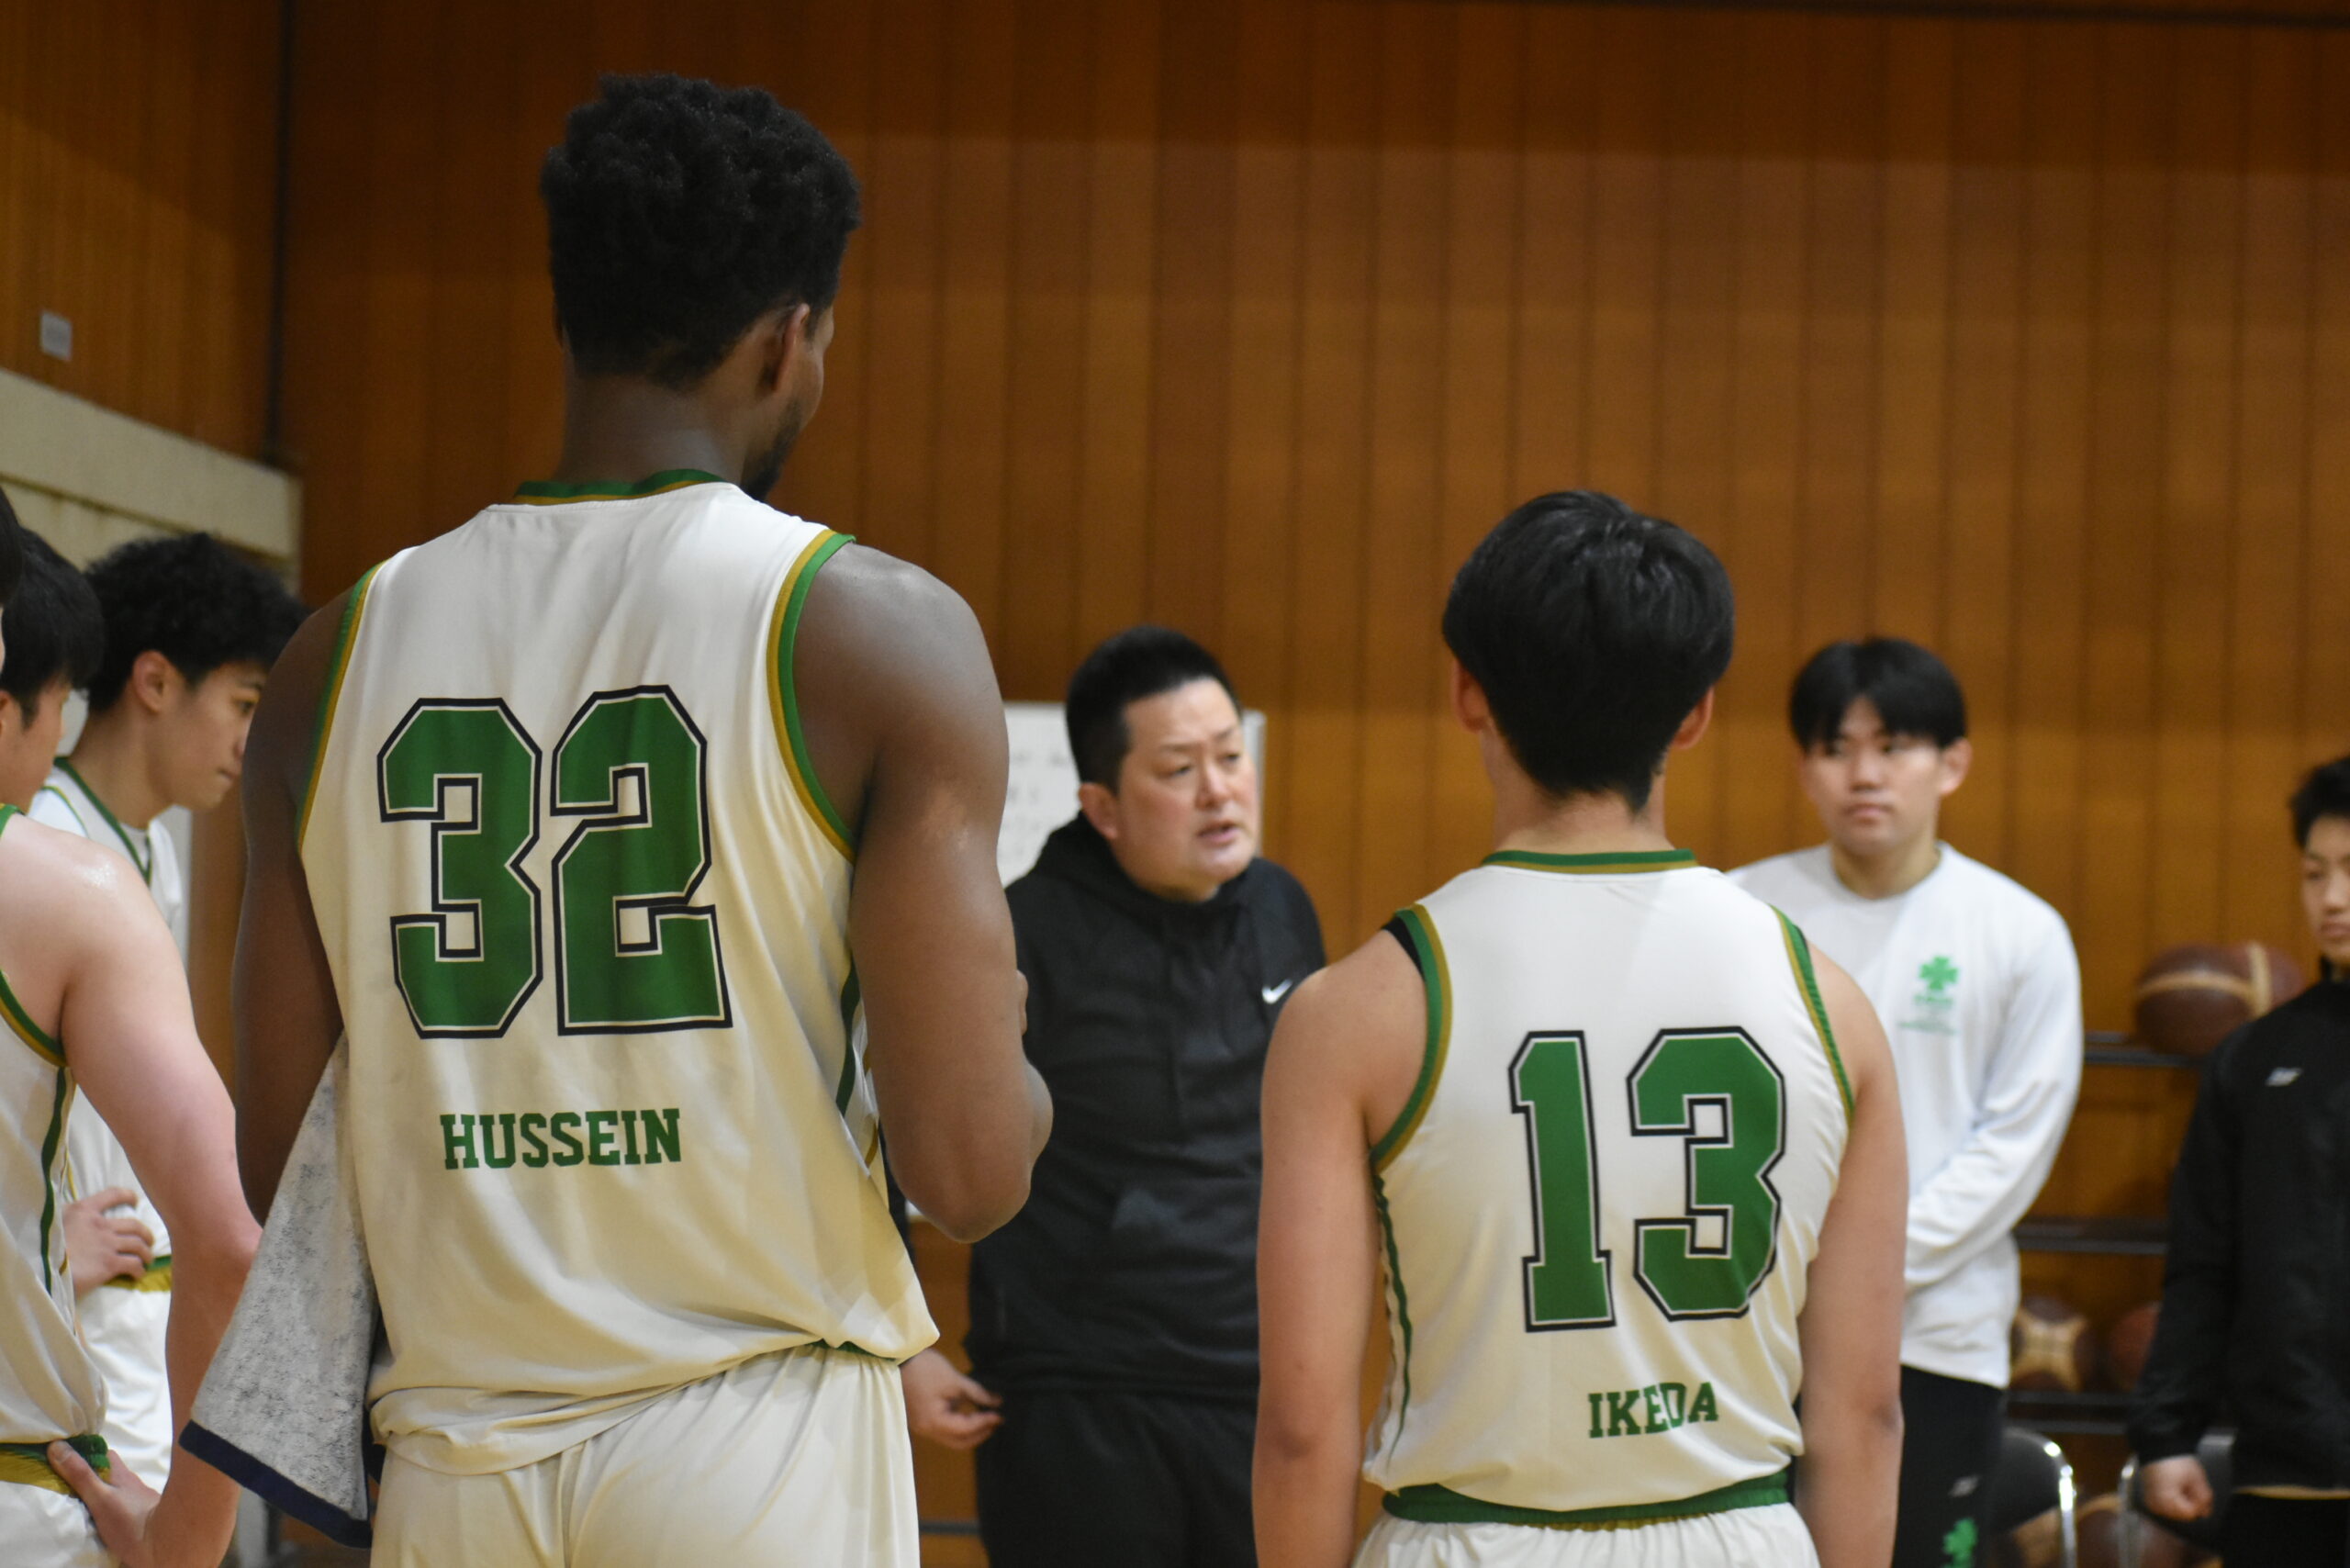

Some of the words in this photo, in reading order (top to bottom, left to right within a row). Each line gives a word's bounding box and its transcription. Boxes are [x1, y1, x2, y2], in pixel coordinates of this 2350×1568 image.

[377, 685, 733, 1039] 32
[441, 1109, 682, 1170] HUSSEIN
[1508, 1026, 1786, 1332] 13
[1588, 1382, 1718, 1439] IKEDA
